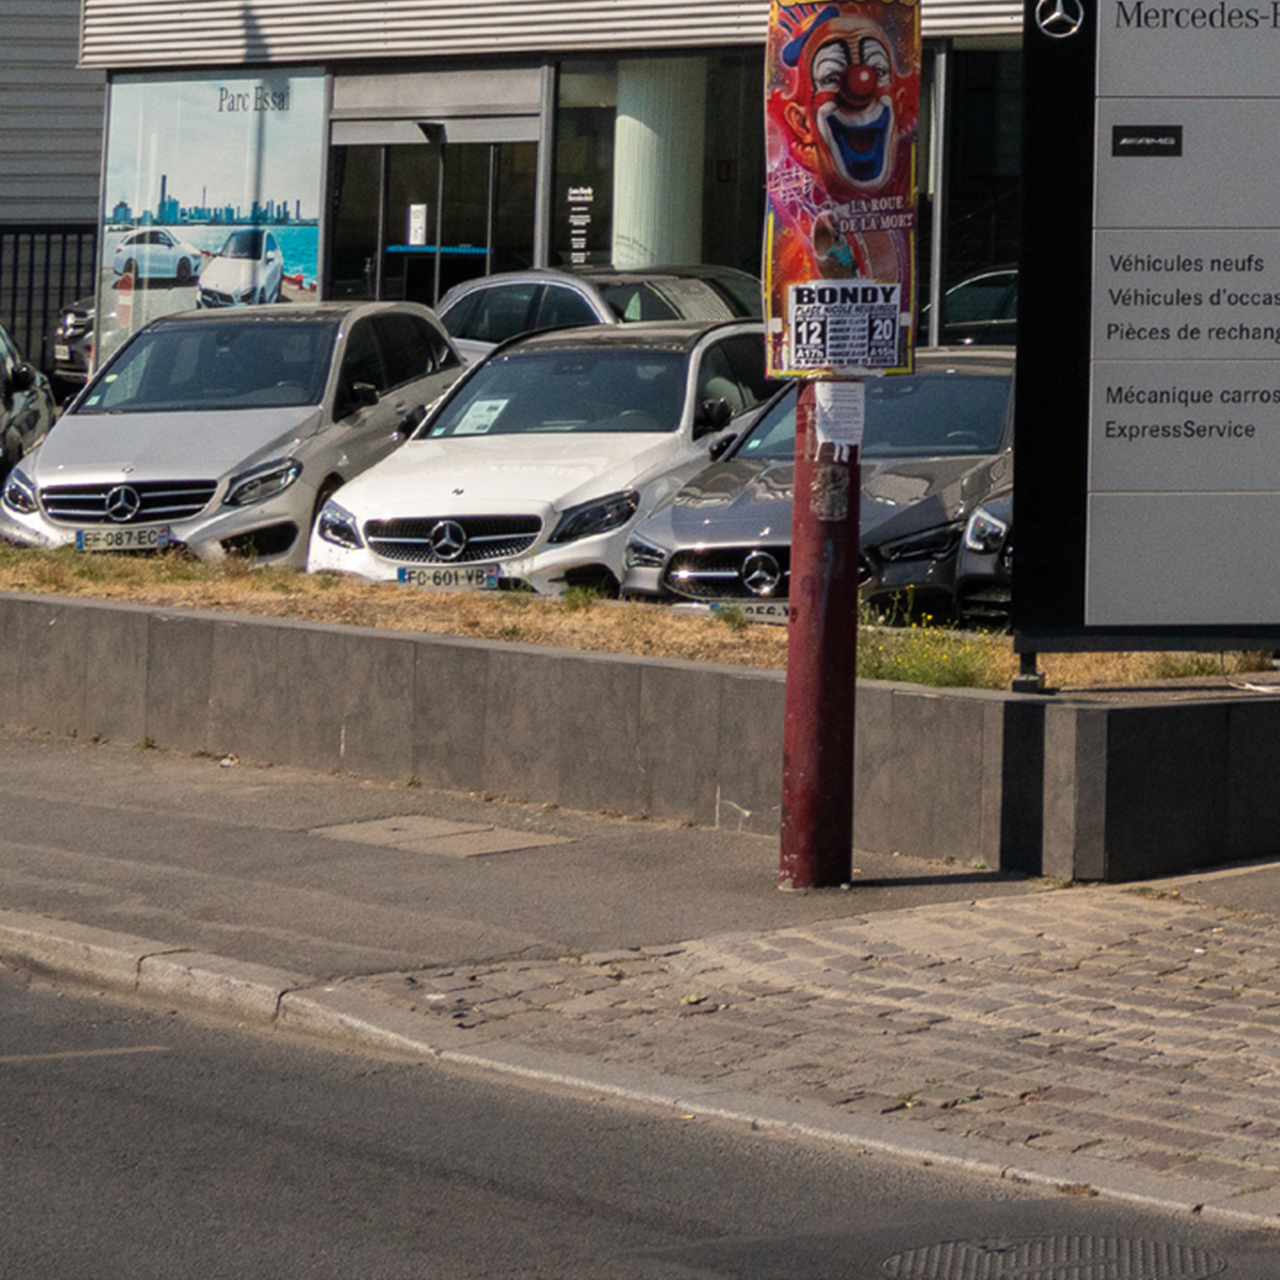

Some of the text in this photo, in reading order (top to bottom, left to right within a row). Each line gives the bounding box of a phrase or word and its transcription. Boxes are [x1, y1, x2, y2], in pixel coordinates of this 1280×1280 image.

[218, 85, 291, 113] Parc Essai
[870, 196, 904, 211] ROUE
[840, 218, 858, 234] DE
[860, 217, 877, 231] LA
[1109, 253, 1265, 272] Véhicules neufs
[795, 286, 897, 305] BONDY
[1108, 288, 1203, 306] Véhicules
[797, 321, 822, 345] 12
[872, 318, 893, 340] 20
[1106, 322, 1171, 340] Pièces
[1177, 323, 1201, 340] de
[1105, 386, 1214, 407] Mécanique
[1104, 420, 1256, 441] ExpressService
